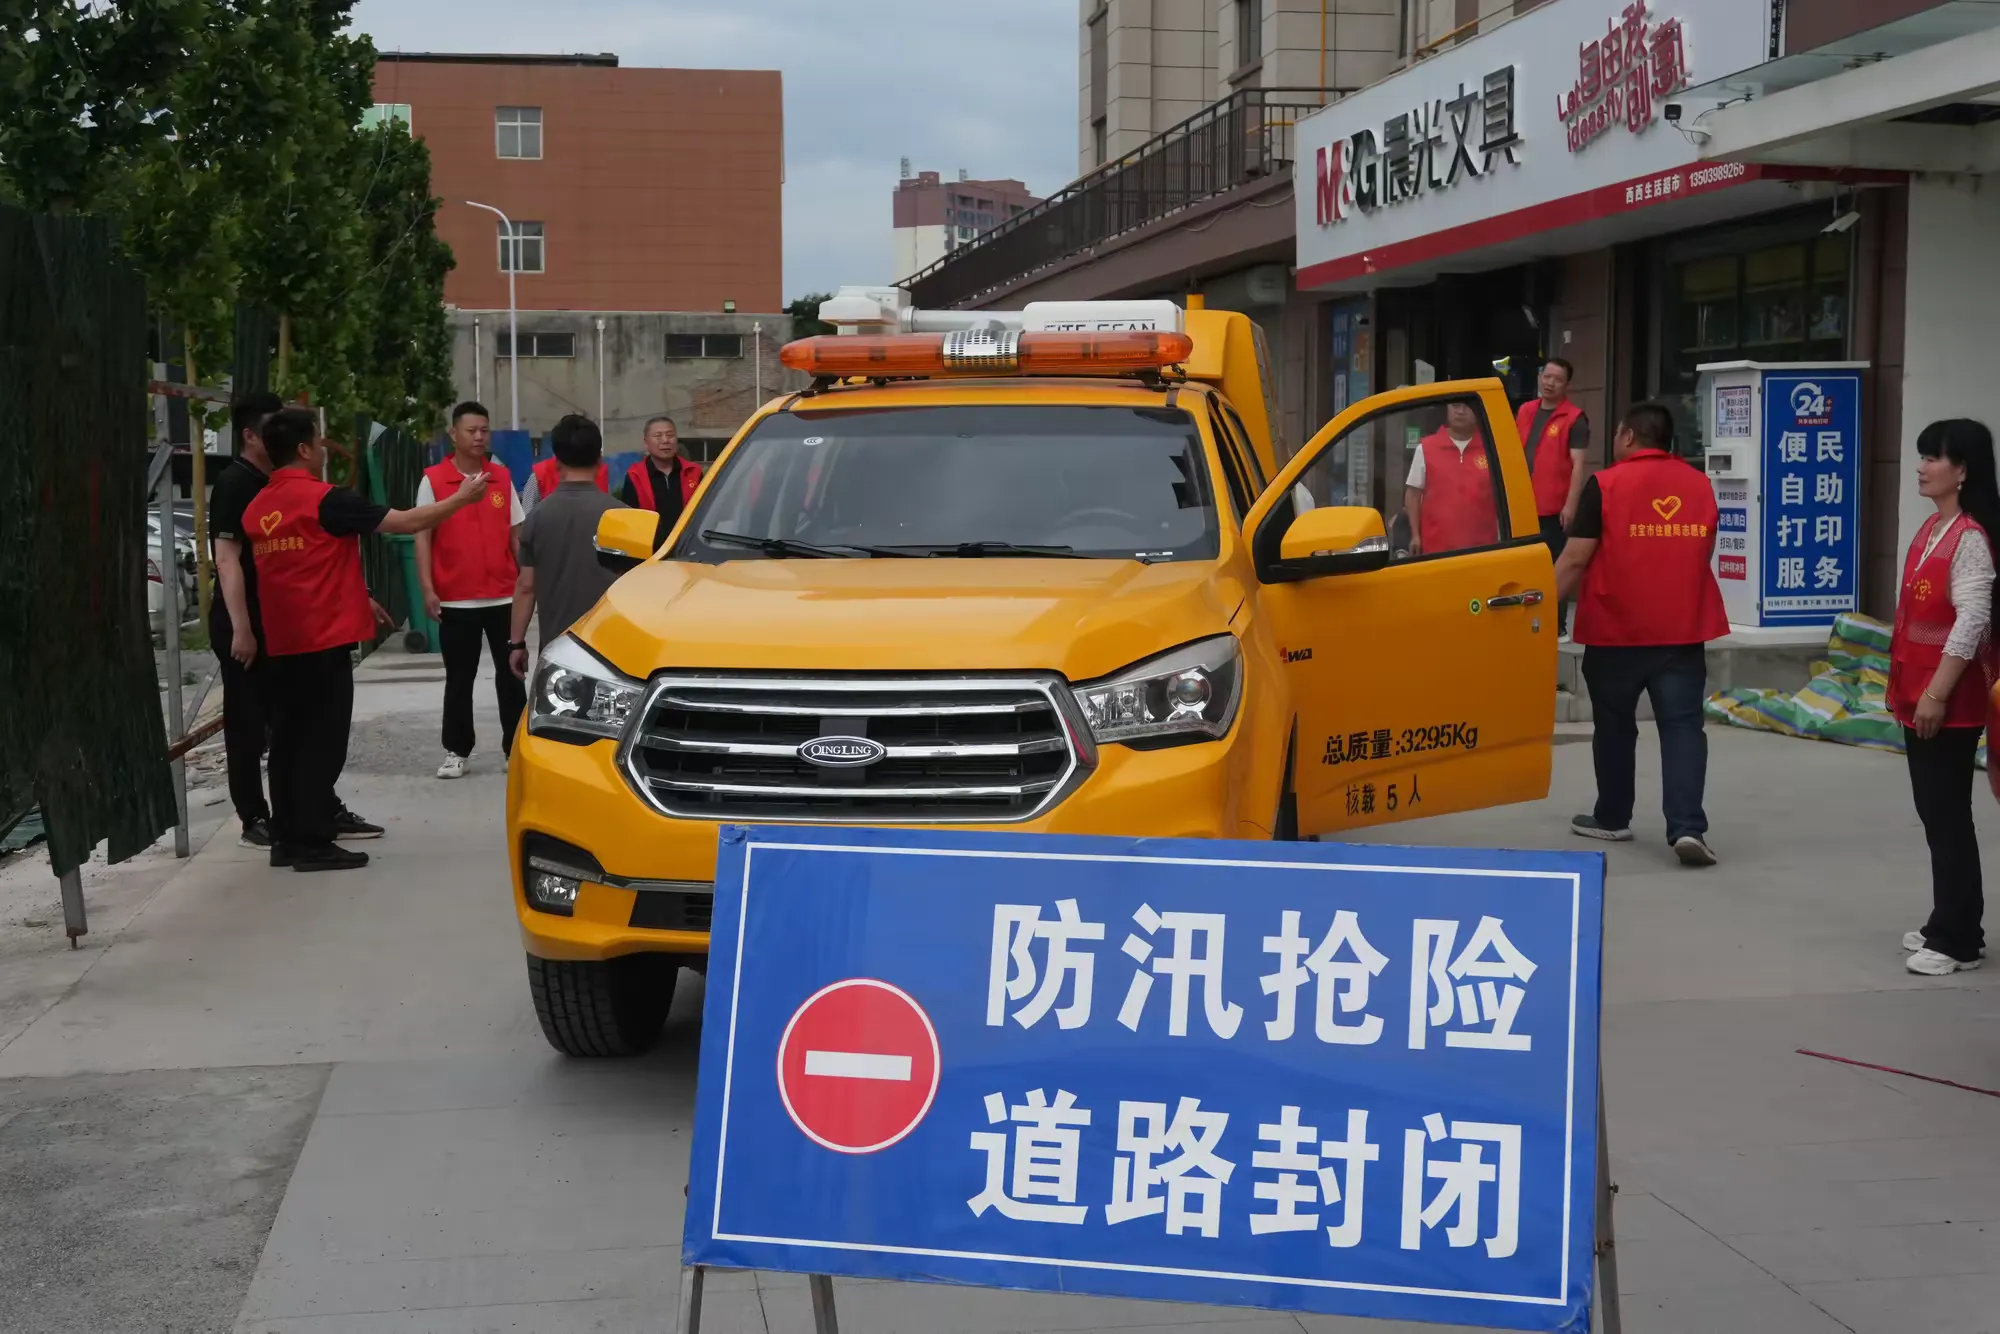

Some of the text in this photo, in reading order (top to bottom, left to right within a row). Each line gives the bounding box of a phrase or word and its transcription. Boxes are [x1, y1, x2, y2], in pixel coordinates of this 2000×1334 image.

[1625, 174, 1681, 204] 西西生活超市
[1795, 394, 1825, 416] 24
[1778, 430, 1844, 463] 便民
[1780, 472, 1844, 506] 自助
[1777, 514, 1843, 548] 打印
[1776, 556, 1844, 590] 服务
[811, 744, 872, 758] QINGLING
[1346, 774, 1421, 817] 核载 5 人
[985, 898, 1539, 1052] 防汛抢险
[966, 1087, 1523, 1259] 道路封闭
